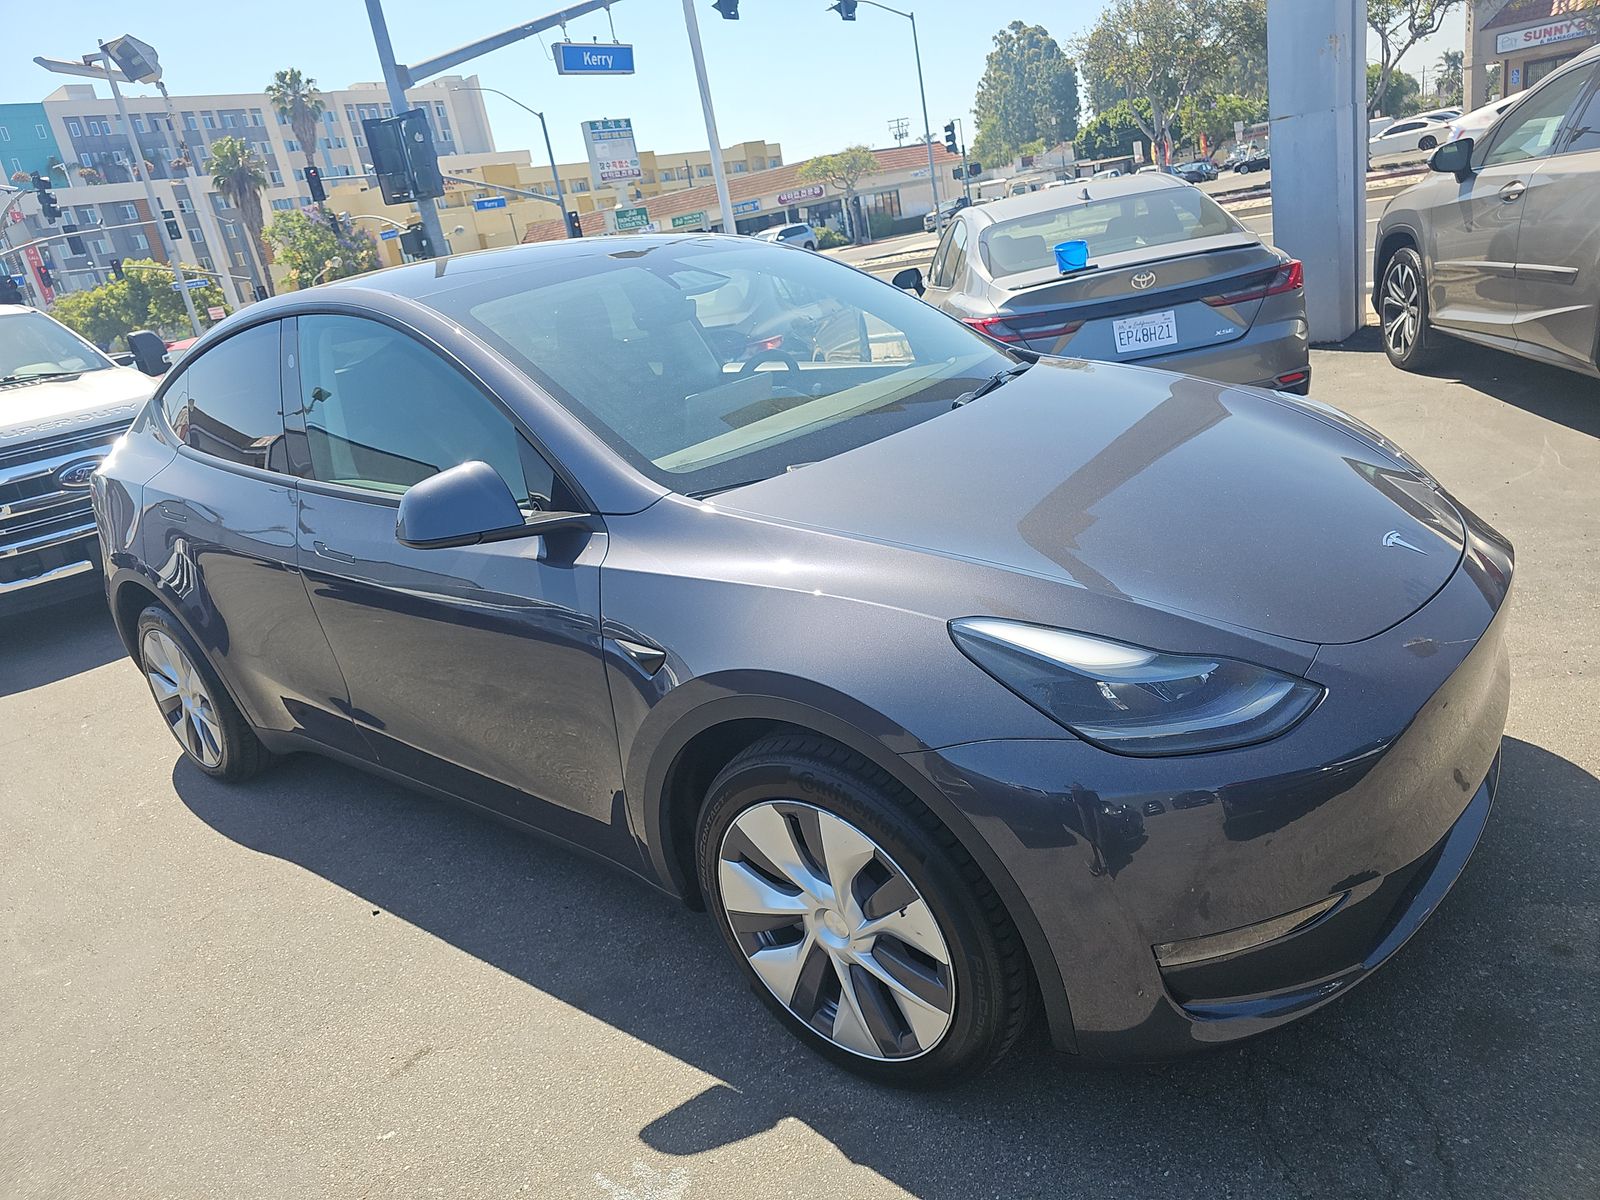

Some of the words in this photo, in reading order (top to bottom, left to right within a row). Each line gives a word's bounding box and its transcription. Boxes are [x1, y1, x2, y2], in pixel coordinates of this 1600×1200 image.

[1523, 22, 1573, 41] SUNNY
[583, 51, 613, 69] Kerry
[1118, 324, 1173, 346] EP48H21
[1214, 328, 1234, 336] XSE
[0, 418, 73, 439] UPER
[75, 403, 137, 422] DUTY
